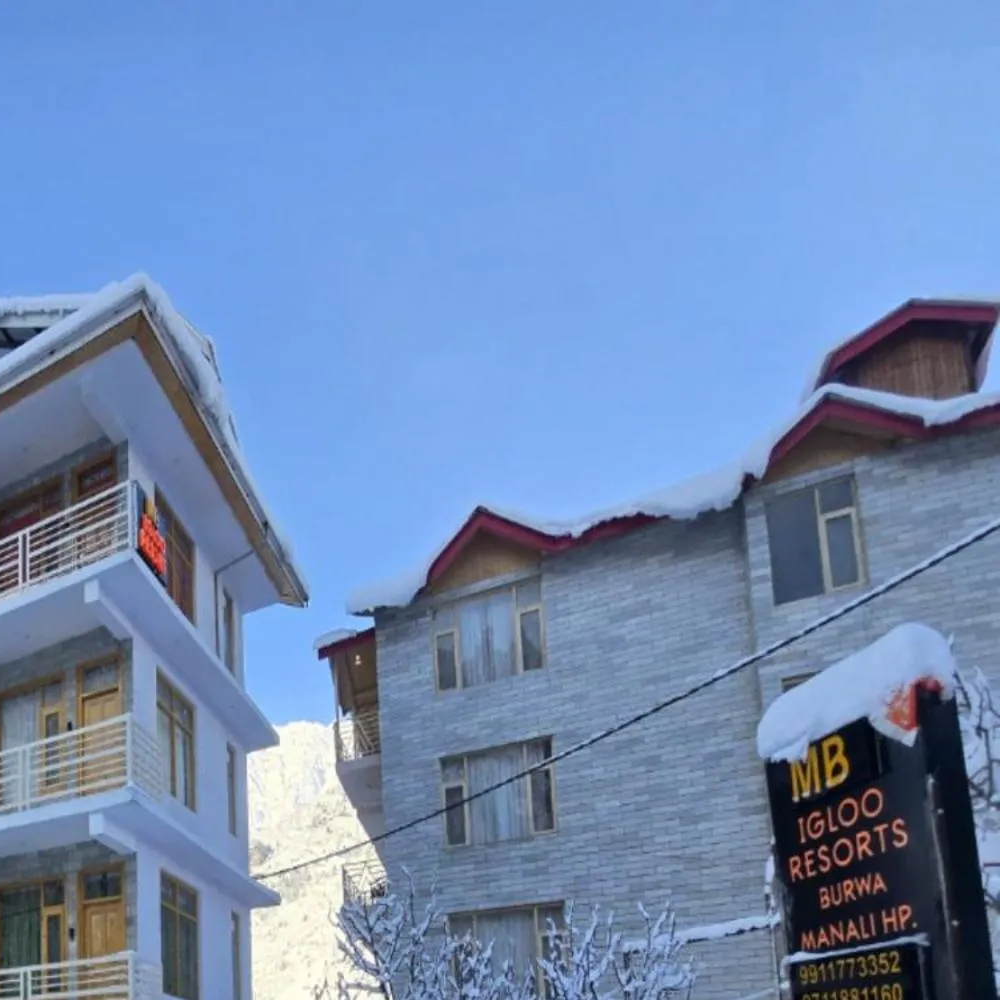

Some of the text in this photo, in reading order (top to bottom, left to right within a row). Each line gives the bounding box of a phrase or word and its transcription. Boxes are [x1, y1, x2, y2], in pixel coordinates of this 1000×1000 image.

[789, 734, 850, 803] MB
[797, 787, 884, 844] IGLOO
[788, 818, 909, 882] RESORTS
[818, 872, 888, 910] BURWA
[800, 912, 877, 950] MANALI
[799, 951, 902, 985] 9911773352
